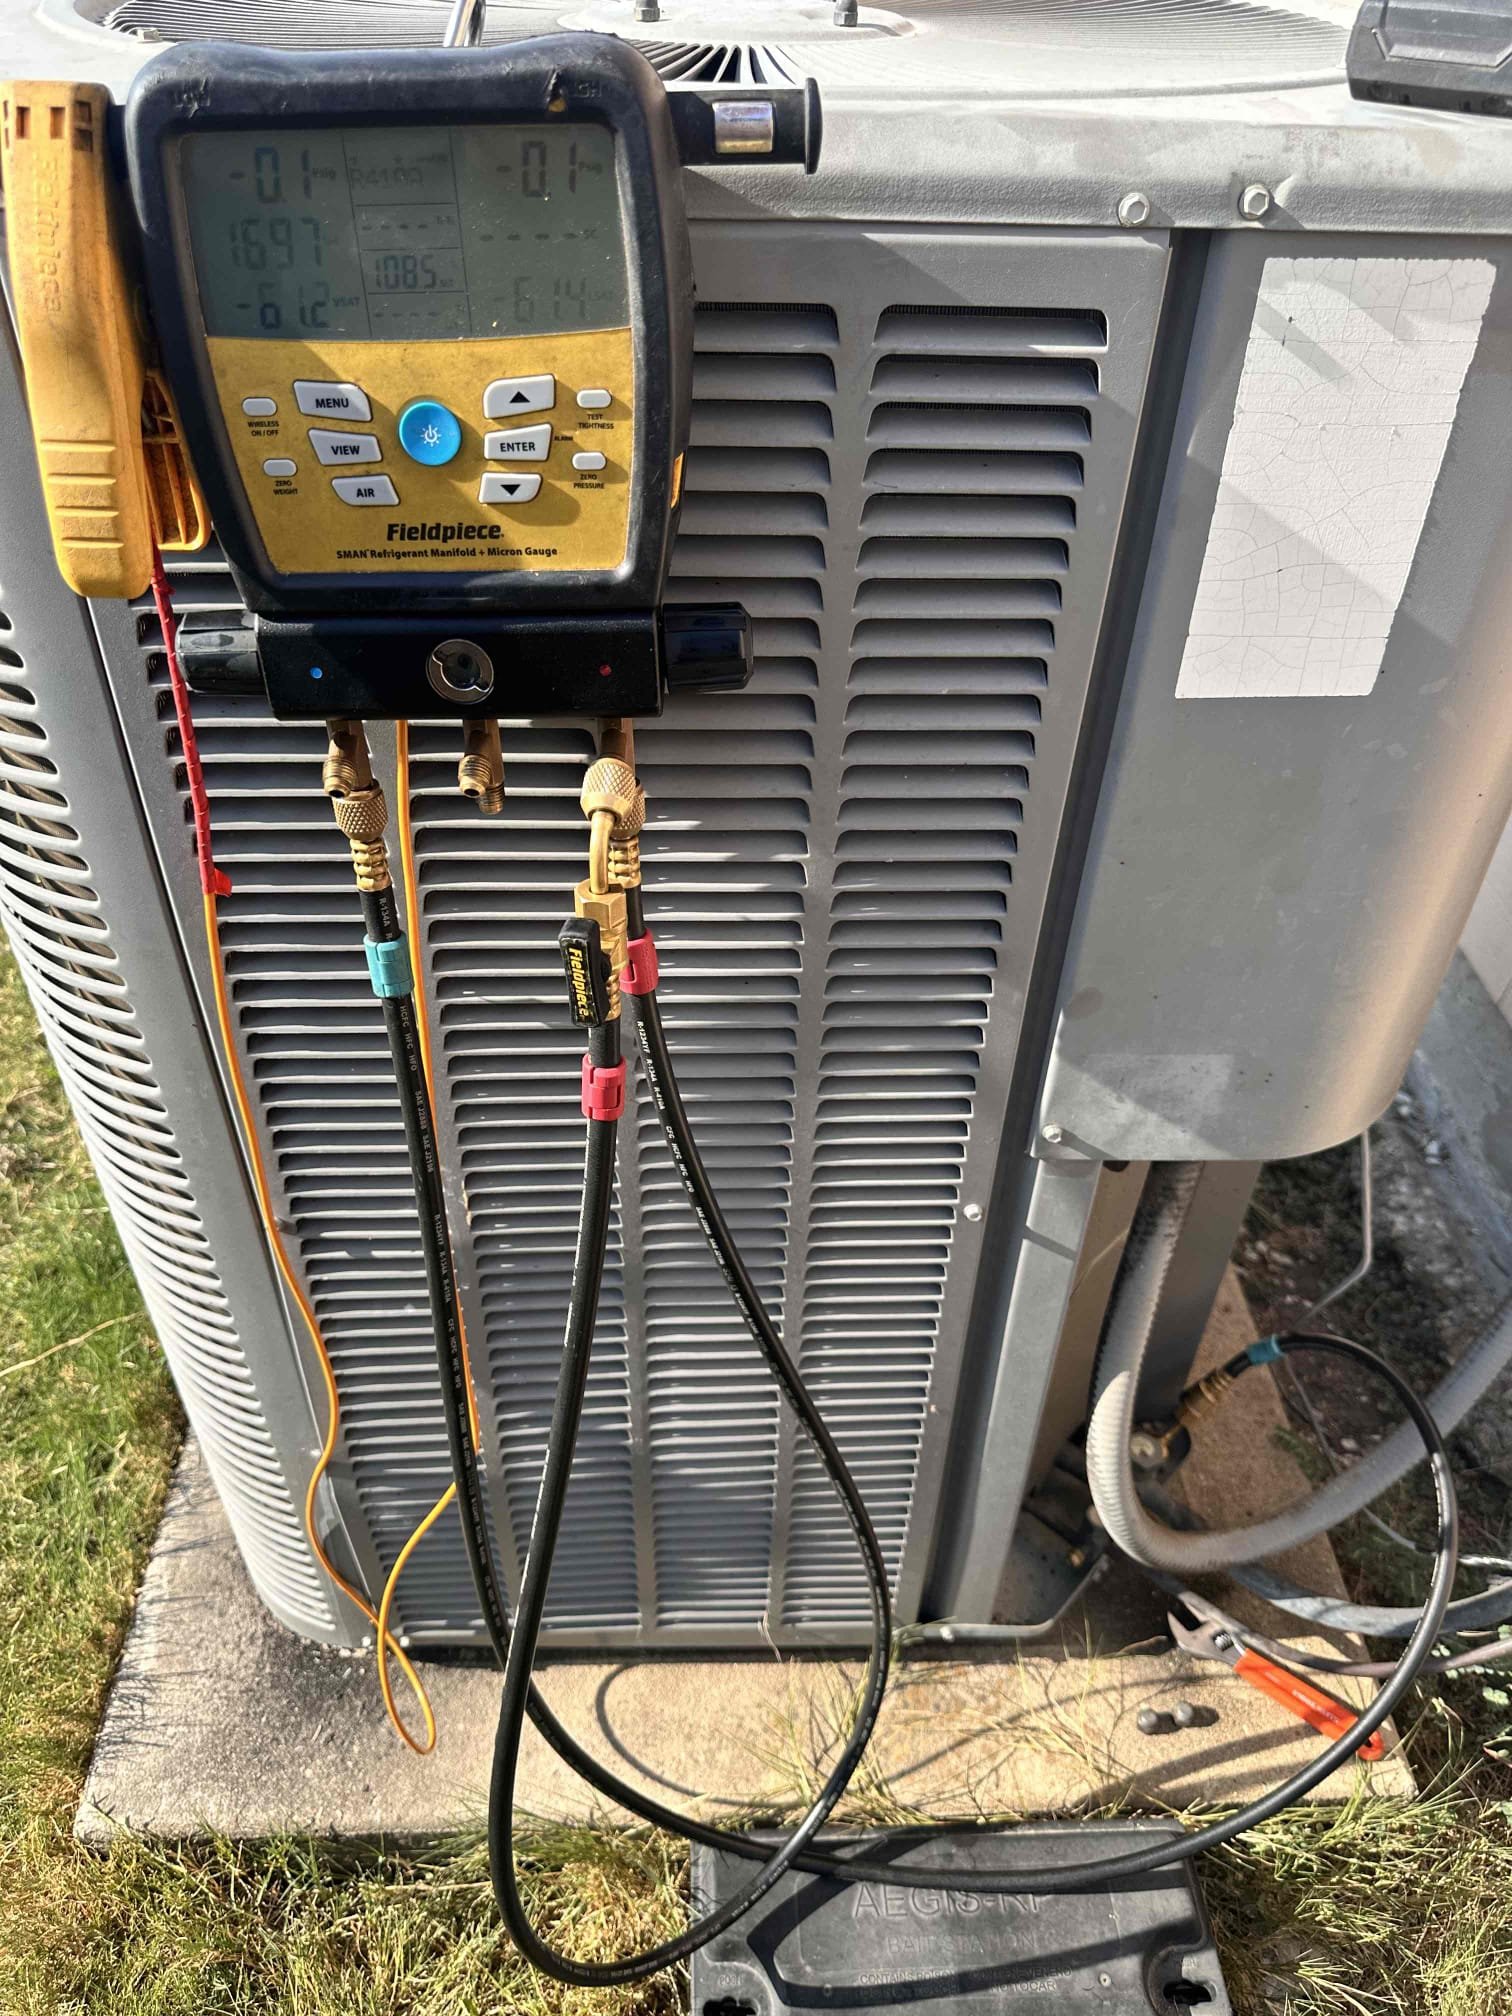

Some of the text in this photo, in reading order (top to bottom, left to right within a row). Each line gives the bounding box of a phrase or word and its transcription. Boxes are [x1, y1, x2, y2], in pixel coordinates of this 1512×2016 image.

[315, 397, 349, 409] MENU
[247, 420, 280, 429] WIRELESS
[578, 421, 615, 430] TIGHTNESS
[266, 429, 280, 437] OFF
[330, 445, 360, 456] VIEW
[499, 441, 536, 453] ENTER
[580, 473, 598, 481] ZERO
[275, 479, 293, 488] ZERO
[573, 482, 605, 490] PRESSURE
[272, 488, 299, 496] WEIGHT
[356, 487, 375, 499] AIR
[386, 522, 502, 544] Fieldpiece
[370, 548, 429, 561] Refrigerant
[430, 547, 477, 558] Manifold
[487, 546, 523, 557] Micron
[524, 546, 558, 558] Gauge
[567, 946, 590, 1019] Fieldpiece
[400, 1005, 418, 1072] HCFC HFC HFO
[1011, 1979, 1057, 1993] TOCAR
